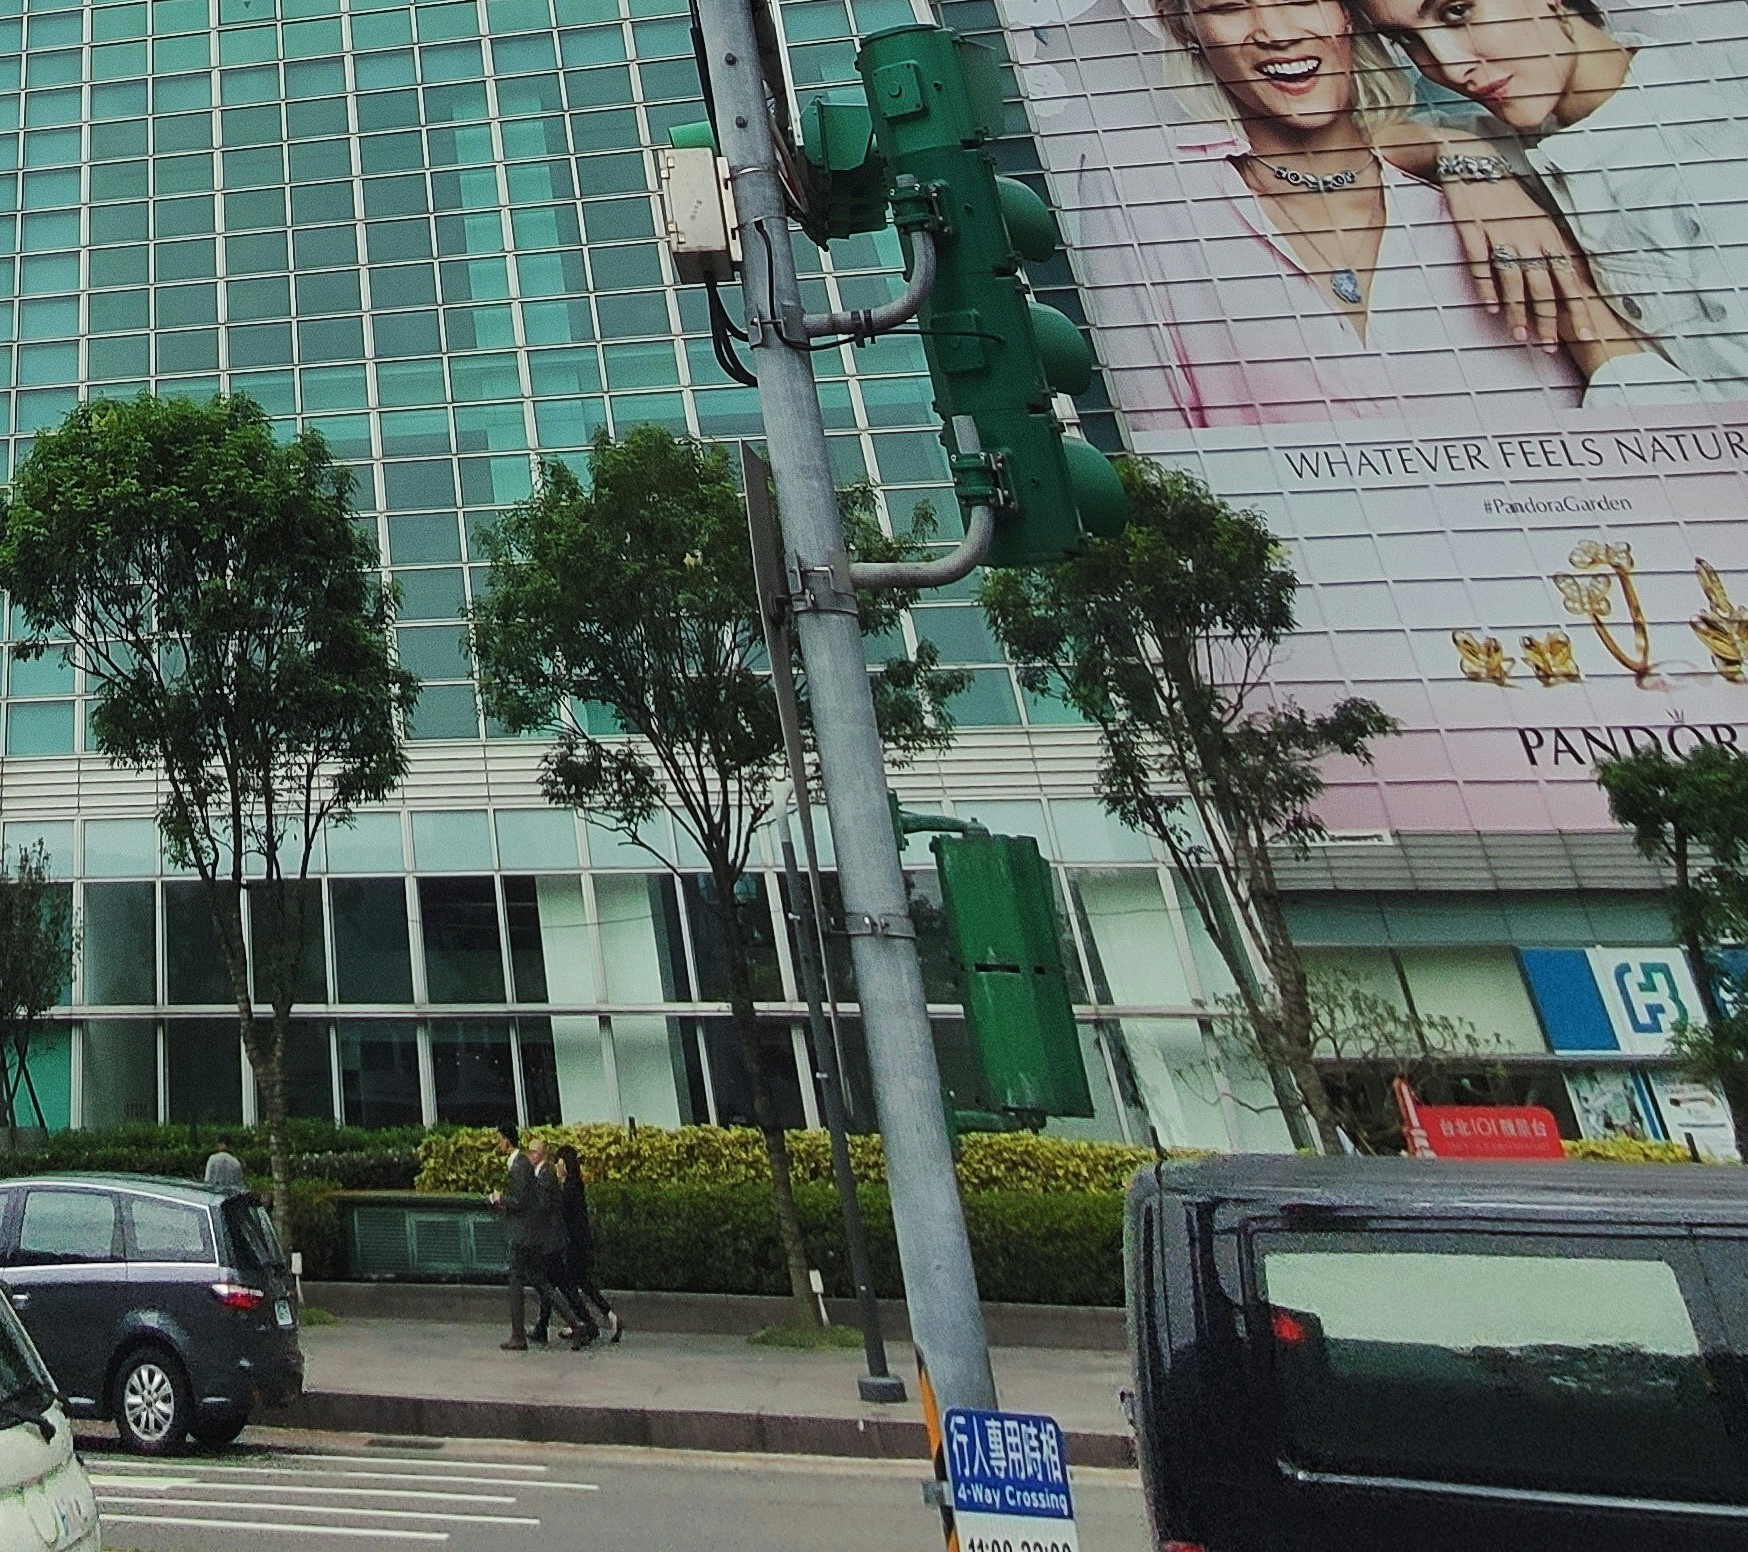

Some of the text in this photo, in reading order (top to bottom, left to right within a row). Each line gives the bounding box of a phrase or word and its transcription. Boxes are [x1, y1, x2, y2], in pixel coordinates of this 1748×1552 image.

[1284, 442, 1490, 478] WHATEVER
[1497, 437, 1603, 469] FEELS
[1483, 494, 1633, 515] #PandoraGarden
[950, 1414, 1064, 1484] 行人專用時相
[957, 1481, 1070, 1517] 4-Way Crossing
